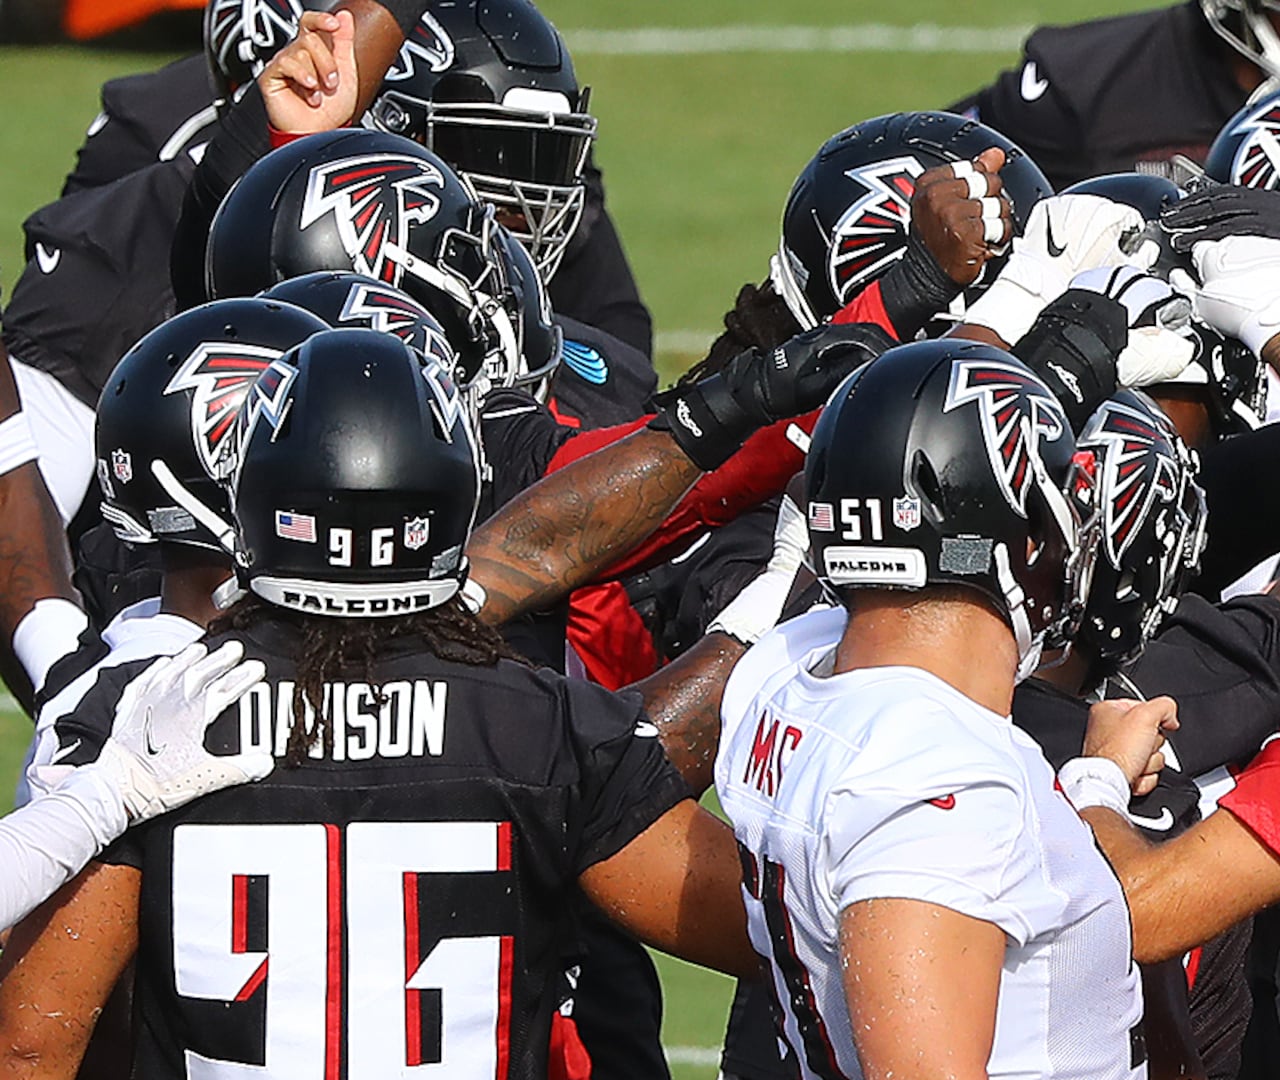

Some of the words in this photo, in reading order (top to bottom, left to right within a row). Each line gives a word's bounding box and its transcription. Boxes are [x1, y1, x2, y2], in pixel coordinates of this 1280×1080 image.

[840, 498, 884, 541] 51
[329, 528, 394, 567] 96
[829, 560, 907, 573] FALCONS
[283, 589, 431, 613] FALCONS
